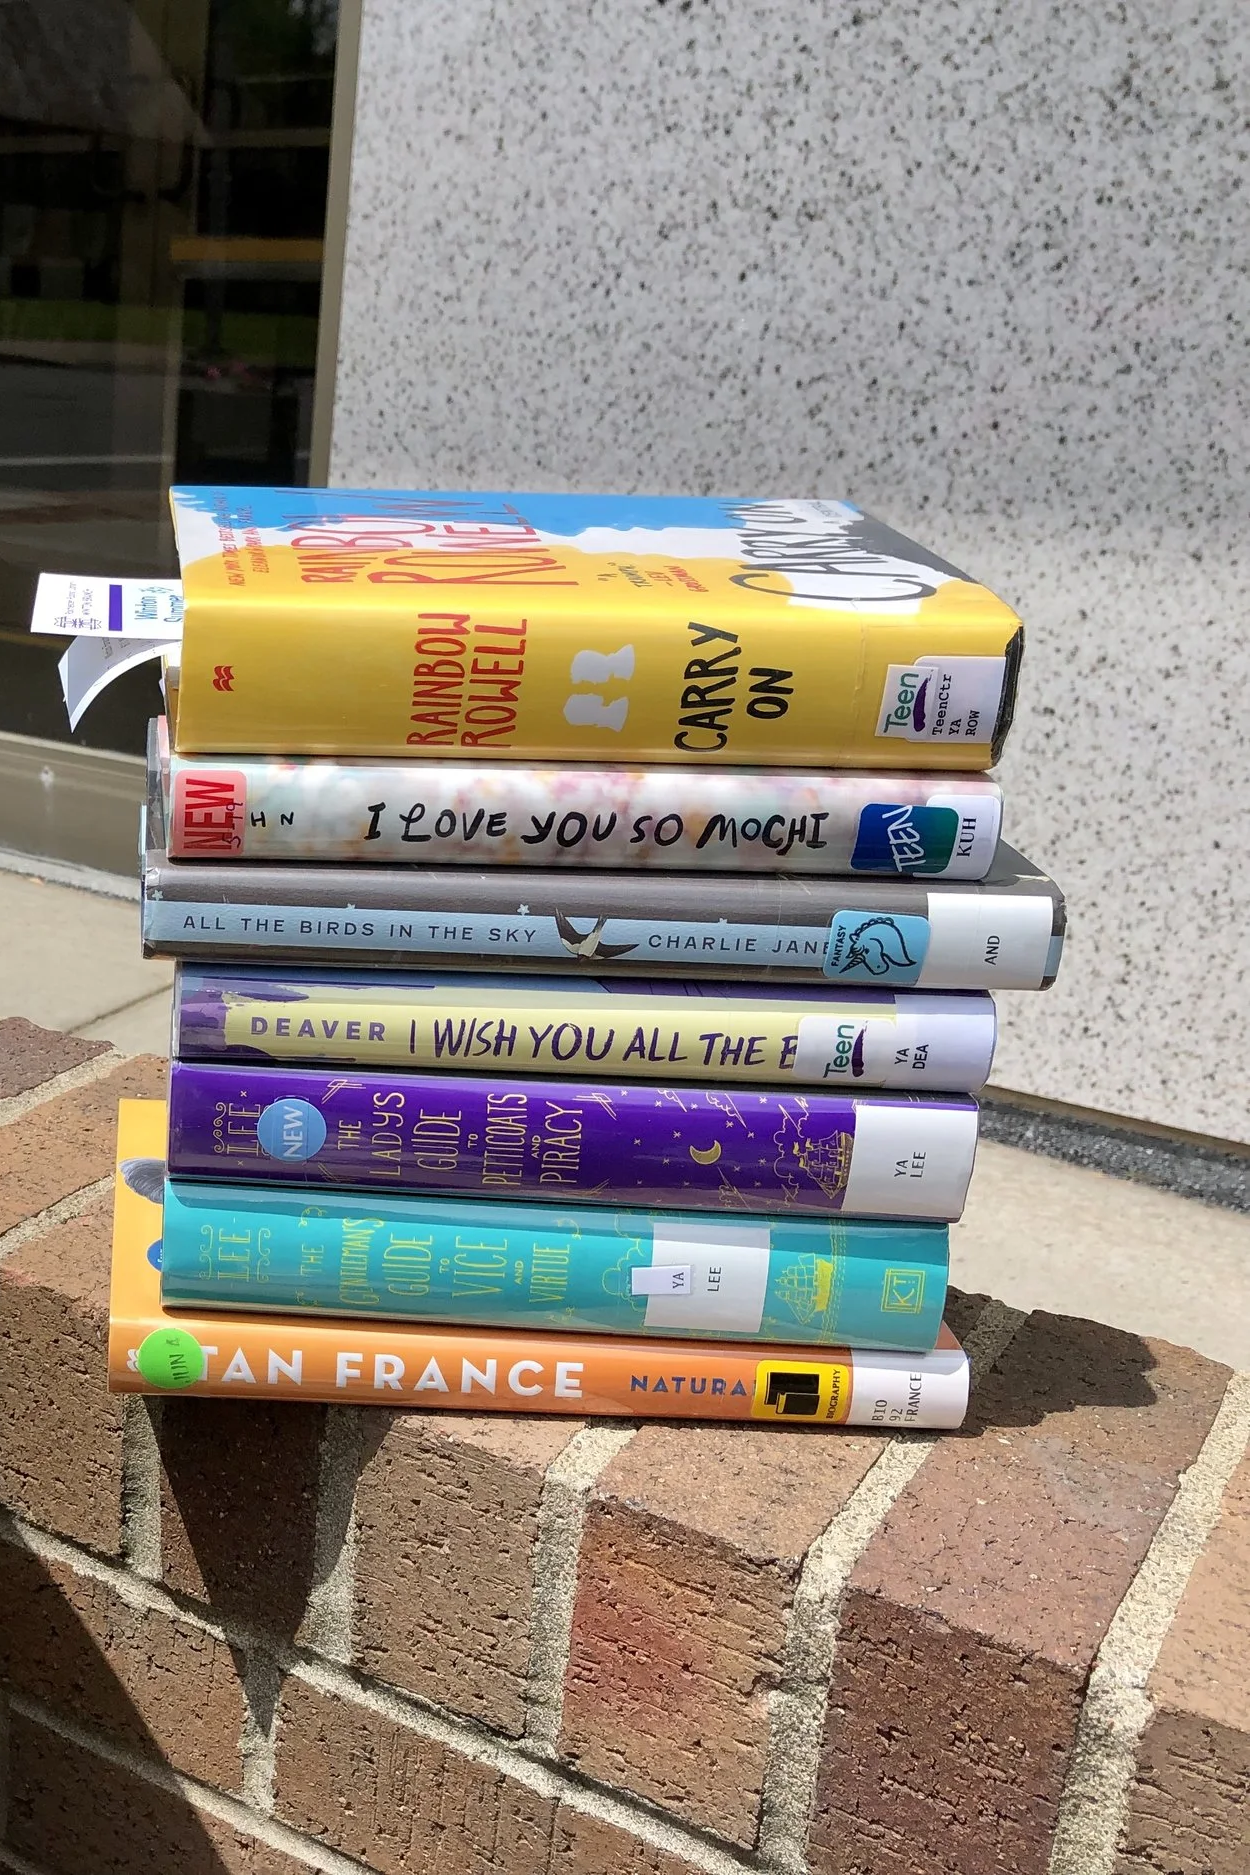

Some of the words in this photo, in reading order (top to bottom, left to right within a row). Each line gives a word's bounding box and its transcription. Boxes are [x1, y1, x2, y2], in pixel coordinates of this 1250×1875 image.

[274, 489, 485, 583] RAINBOW
[717, 502, 808, 524] ON
[366, 503, 580, 586] ROWELL
[727, 526, 938, 602] CARRY
[406, 612, 472, 747] RAINBOW
[460, 617, 529, 749] ROWELL
[673, 621, 743, 753] CARRY
[746, 666, 794, 720] ON
[883, 672, 920, 735] Teen
[932, 673, 952, 736] TeenCtr
[949, 717, 962, 737] YA
[965, 709, 980, 737] ROW
[183, 778, 235, 851] NEW
[363, 801, 387, 842] I
[399, 801, 509, 843] LOVE
[520, 810, 618, 849] YOU
[629, 813, 684, 847] SO
[695, 811, 830, 856] MOCHI
[881, 804, 927, 873] TEEN
[956, 817, 977, 858] KUH
[182, 914, 227, 931] ALL
[241, 917, 285, 933] THE
[300, 920, 375, 938] BIRDS
[390, 924, 414, 939] IN
[428, 925, 474, 942] THE
[488, 927, 538, 944] SKY
[648, 934, 758, 953] CHARLIE
[831, 924, 847, 967] FANTASY
[983, 934, 1001, 966] AND
[251, 1015, 387, 1043] DEAVER
[408, 1019, 417, 1055] I
[433, 1018, 518, 1058] WISH
[528, 1022, 616, 1062] YOU
[621, 1026, 689, 1064] ALL
[698, 1032, 768, 1067] THE
[822, 1023, 855, 1079] Teen
[894, 1047, 910, 1066] YA
[911, 1043, 930, 1071] DEA
[226, 1102, 262, 1157] LEE
[282, 1105, 304, 1158] NEW
[337, 1119, 362, 1151] THE
[369, 1091, 406, 1177] LADY'S
[411, 1108, 462, 1172] GUIDE
[467, 1132, 478, 1148] TO
[481, 1092, 528, 1187] PETTICOATS
[531, 1133, 541, 1159] AND
[539, 1100, 584, 1185] PIRACY
[893, 1159, 907, 1178] YA
[909, 1150, 927, 1179] LEE
[217, 1226, 252, 1283] LEE
[299, 1243, 325, 1278] THE
[338, 1216, 385, 1306] GENTLEMAN'S
[382, 1233, 434, 1298] GUIDE
[437, 1257, 450, 1275] TO
[451, 1234, 509, 1299] VICE
[513, 1259, 525, 1286] AND
[528, 1241, 572, 1304] VIRTUE
[671, 1270, 686, 1290] YA
[707, 1265, 723, 1293] LEE
[334, 1349, 586, 1399] FRANCE
[630, 1374, 756, 1397] NATURA
[825, 1368, 842, 1421] BIOGRAPHY
[905, 1372, 923, 1423] FRANCE
[871, 1399, 888, 1423] BIO
[890, 1407, 904, 1423] 92
